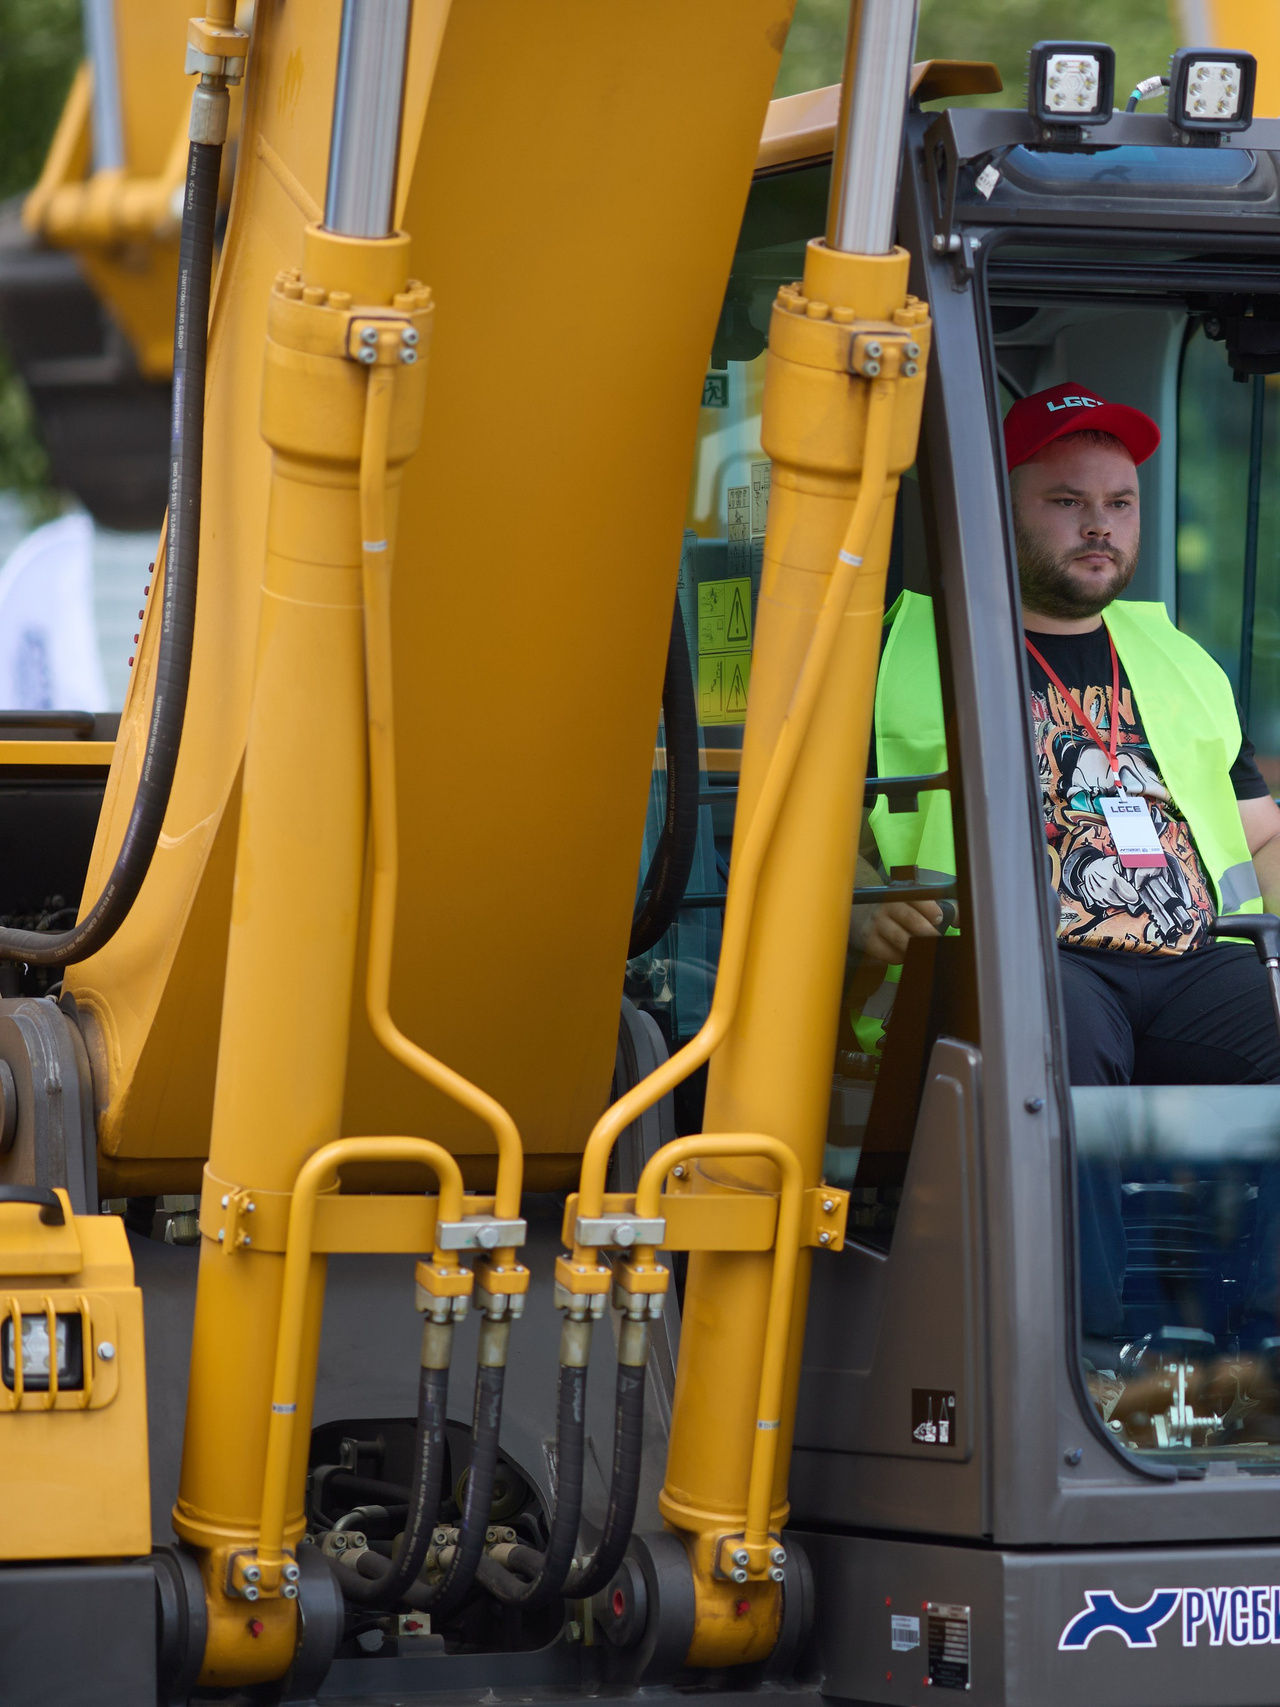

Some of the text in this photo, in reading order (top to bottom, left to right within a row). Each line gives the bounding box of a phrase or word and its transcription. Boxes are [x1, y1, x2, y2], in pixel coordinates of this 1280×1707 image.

[180, 269, 188, 306] SUMITOMO
[177, 325, 185, 350] GROUP
[152, 695, 162, 735] SUMITOMO
[144, 755, 153, 782] GROUP
[1110, 805, 1142, 813] LGCE
